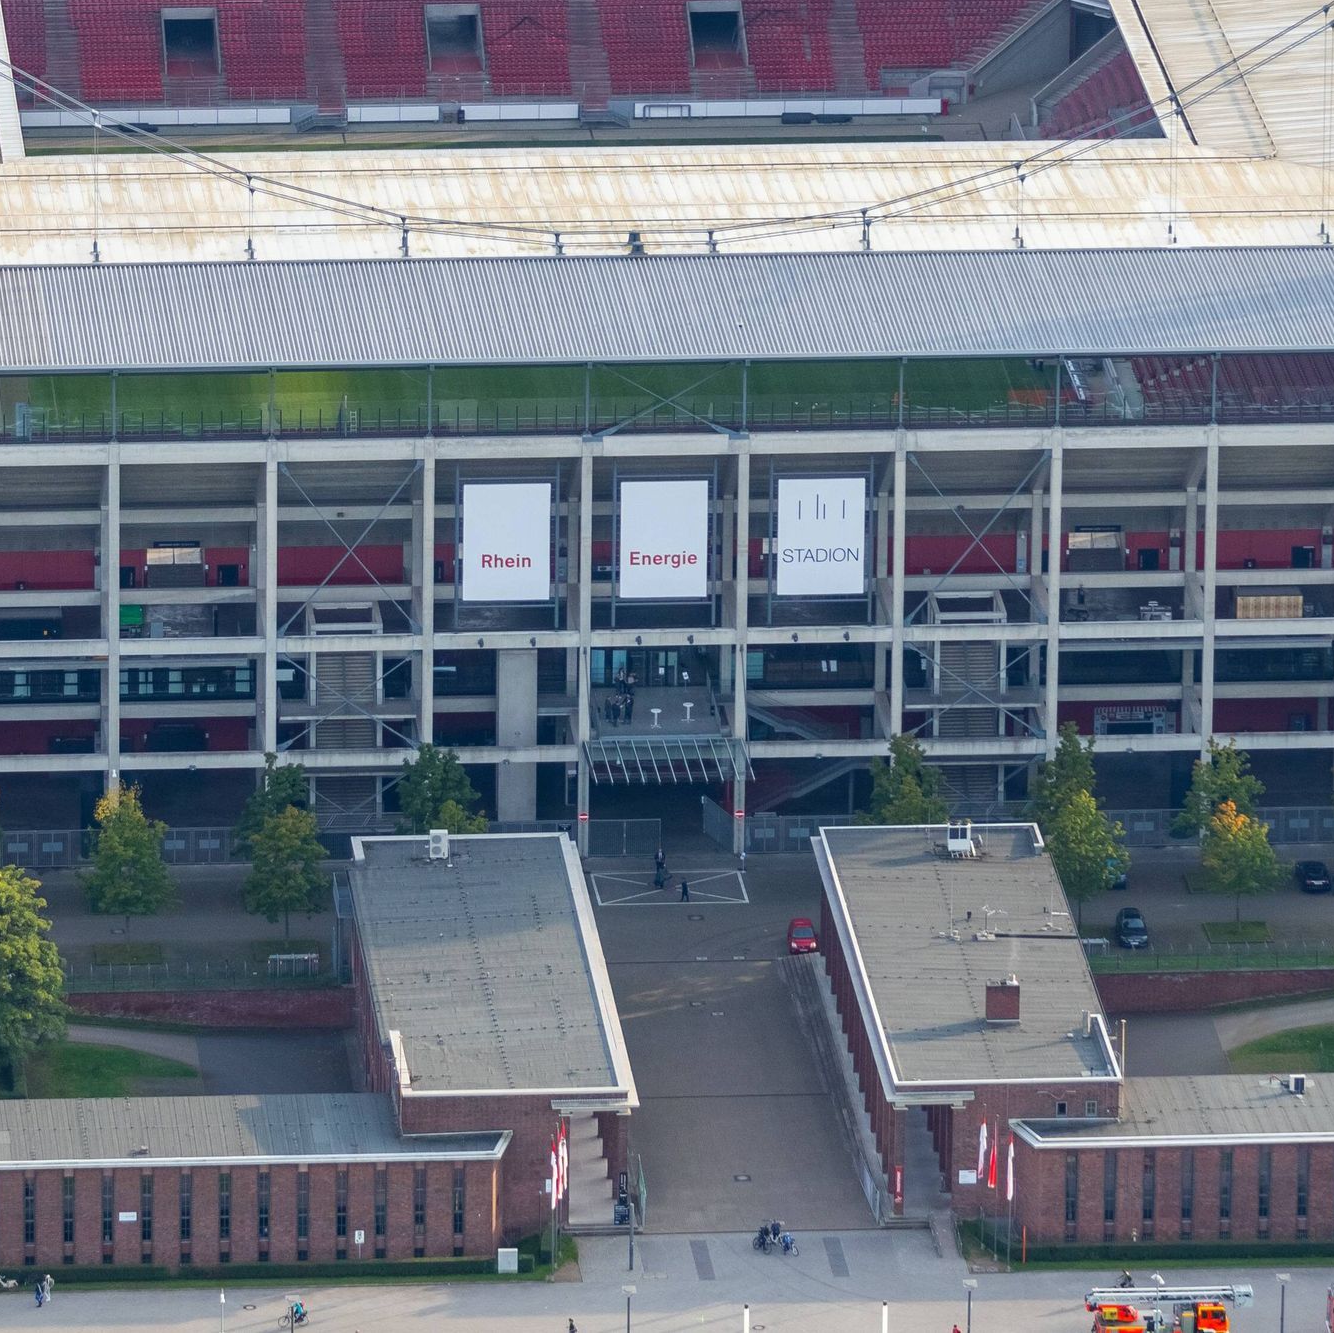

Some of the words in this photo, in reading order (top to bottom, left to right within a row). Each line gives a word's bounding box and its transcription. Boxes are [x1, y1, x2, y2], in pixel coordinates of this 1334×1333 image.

[481, 553, 532, 569] Rhein
[629, 550, 698, 569] Energie
[782, 547, 859, 564] STADION
